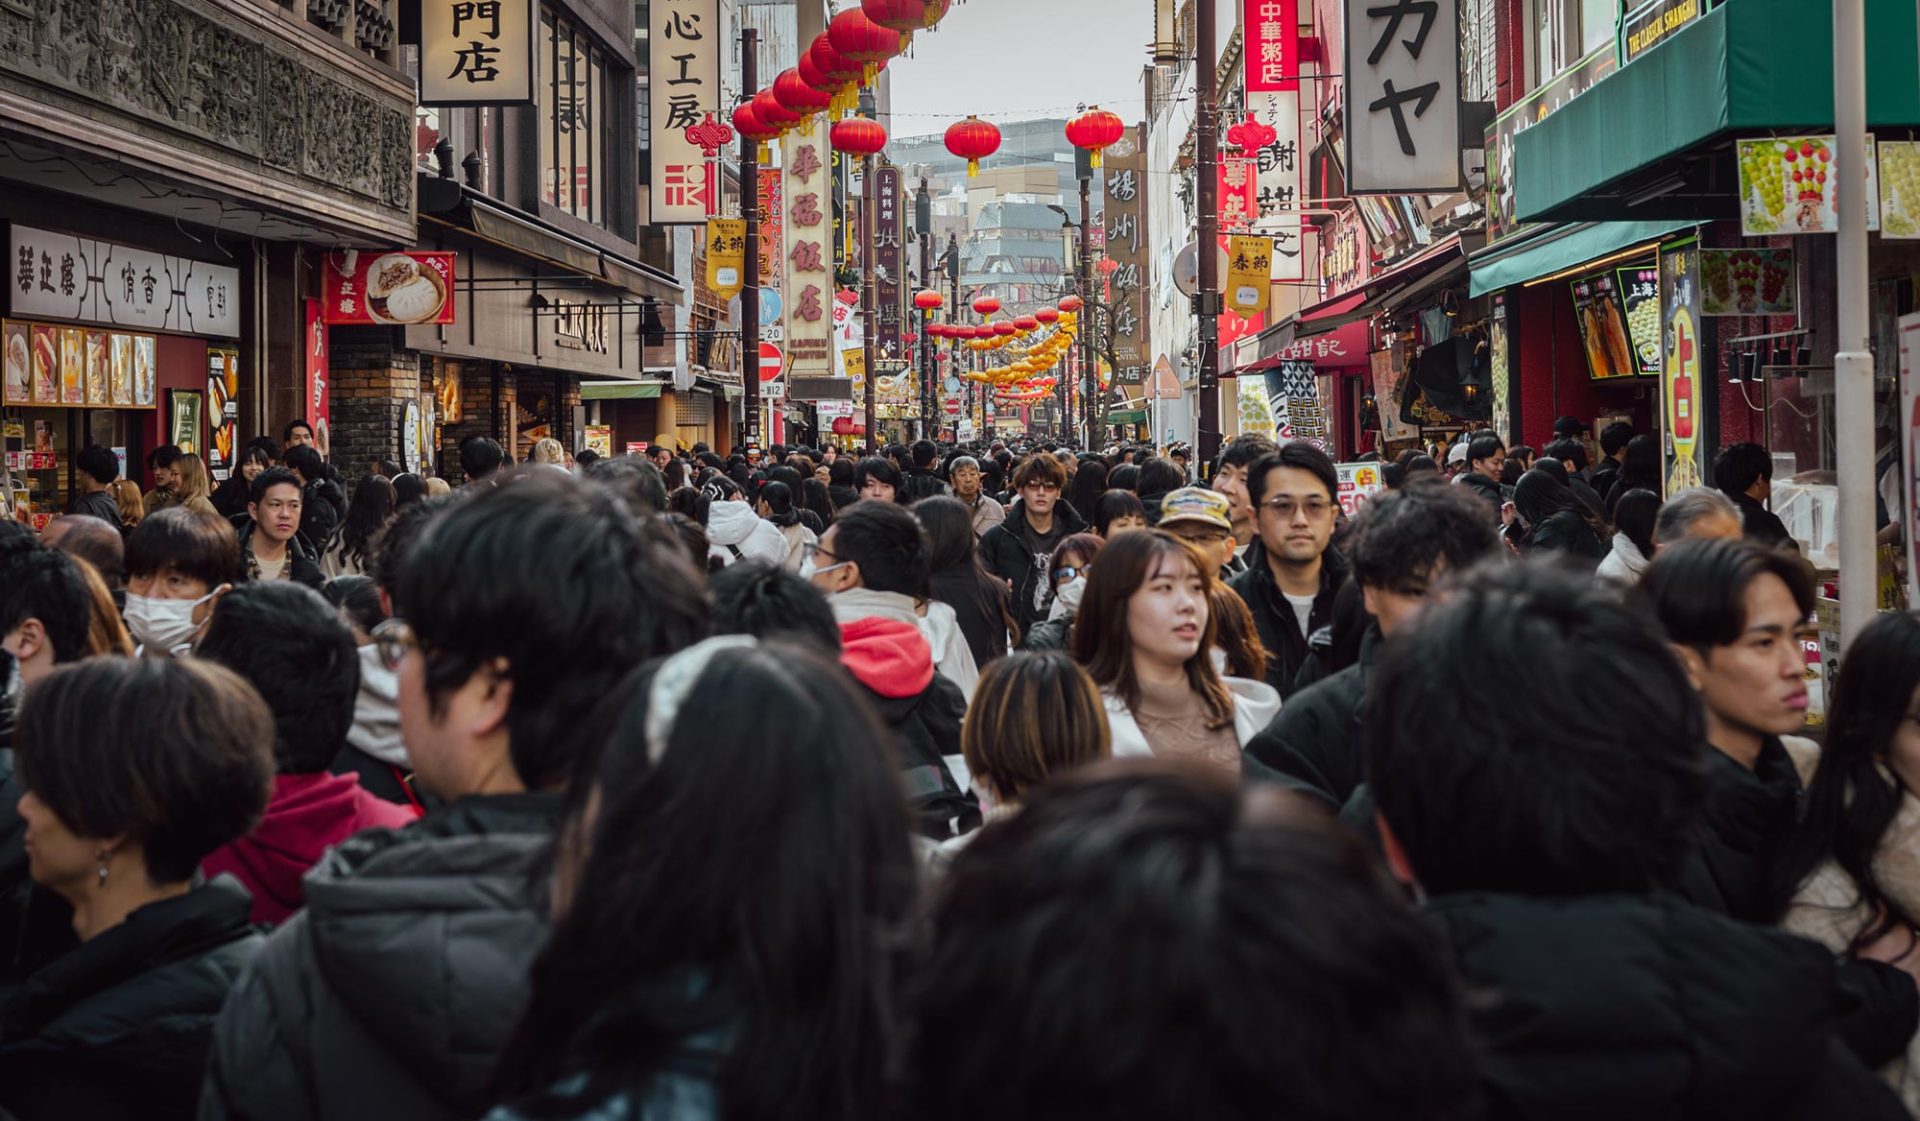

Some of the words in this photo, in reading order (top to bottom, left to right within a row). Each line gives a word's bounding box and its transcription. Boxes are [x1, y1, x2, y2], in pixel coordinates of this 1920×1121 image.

[447, 0, 501, 83] 門店
[664, 0, 703, 130] 心工房
[1259, 1, 1282, 84] 中華粥店
[789, 144, 826, 322] 華福飯店
[881, 174, 893, 220] 上海料理
[711, 235, 744, 253] 春節
[1232, 253, 1269, 272] 春節
